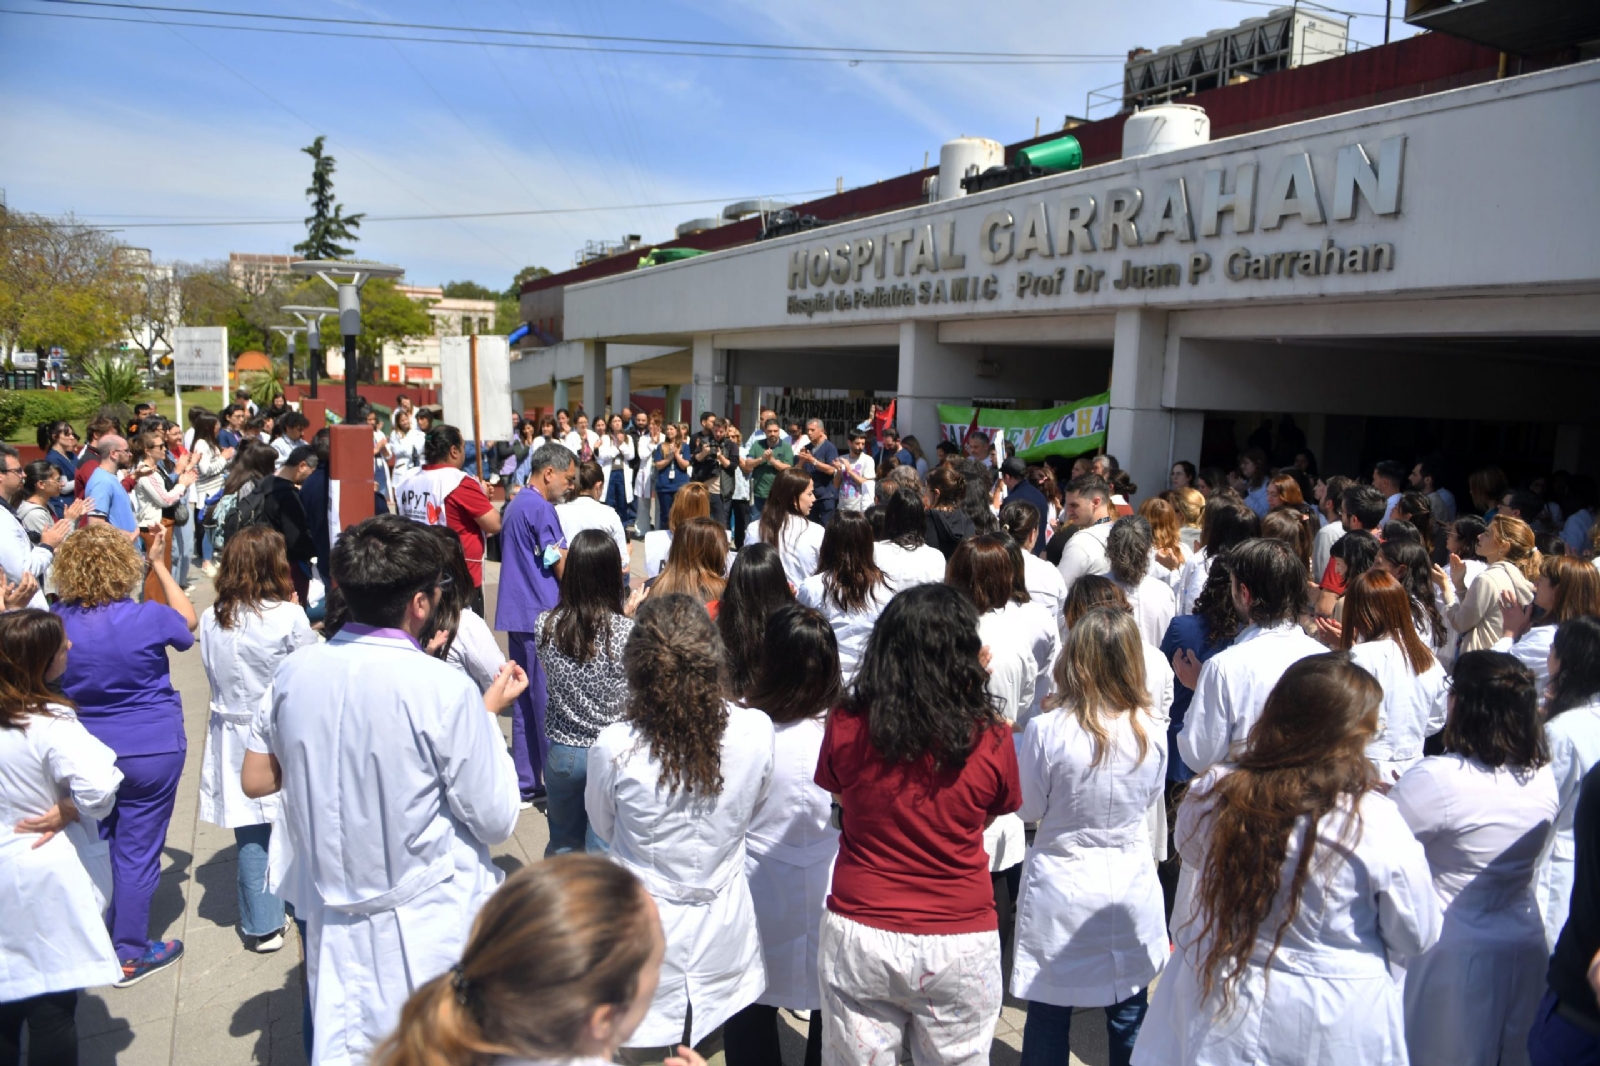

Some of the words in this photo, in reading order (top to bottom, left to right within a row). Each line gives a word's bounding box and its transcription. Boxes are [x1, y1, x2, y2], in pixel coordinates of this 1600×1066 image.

[787, 219, 967, 292] HOSPITAL
[979, 134, 1408, 265] GARRAHAN
[787, 291, 834, 317] Hospital
[835, 290, 853, 311] de
[1113, 260, 1181, 290] Juan
[1224, 239, 1395, 282] Garrahan
[1008, 427, 1038, 451] EN
[1035, 406, 1104, 446] LUCHA
